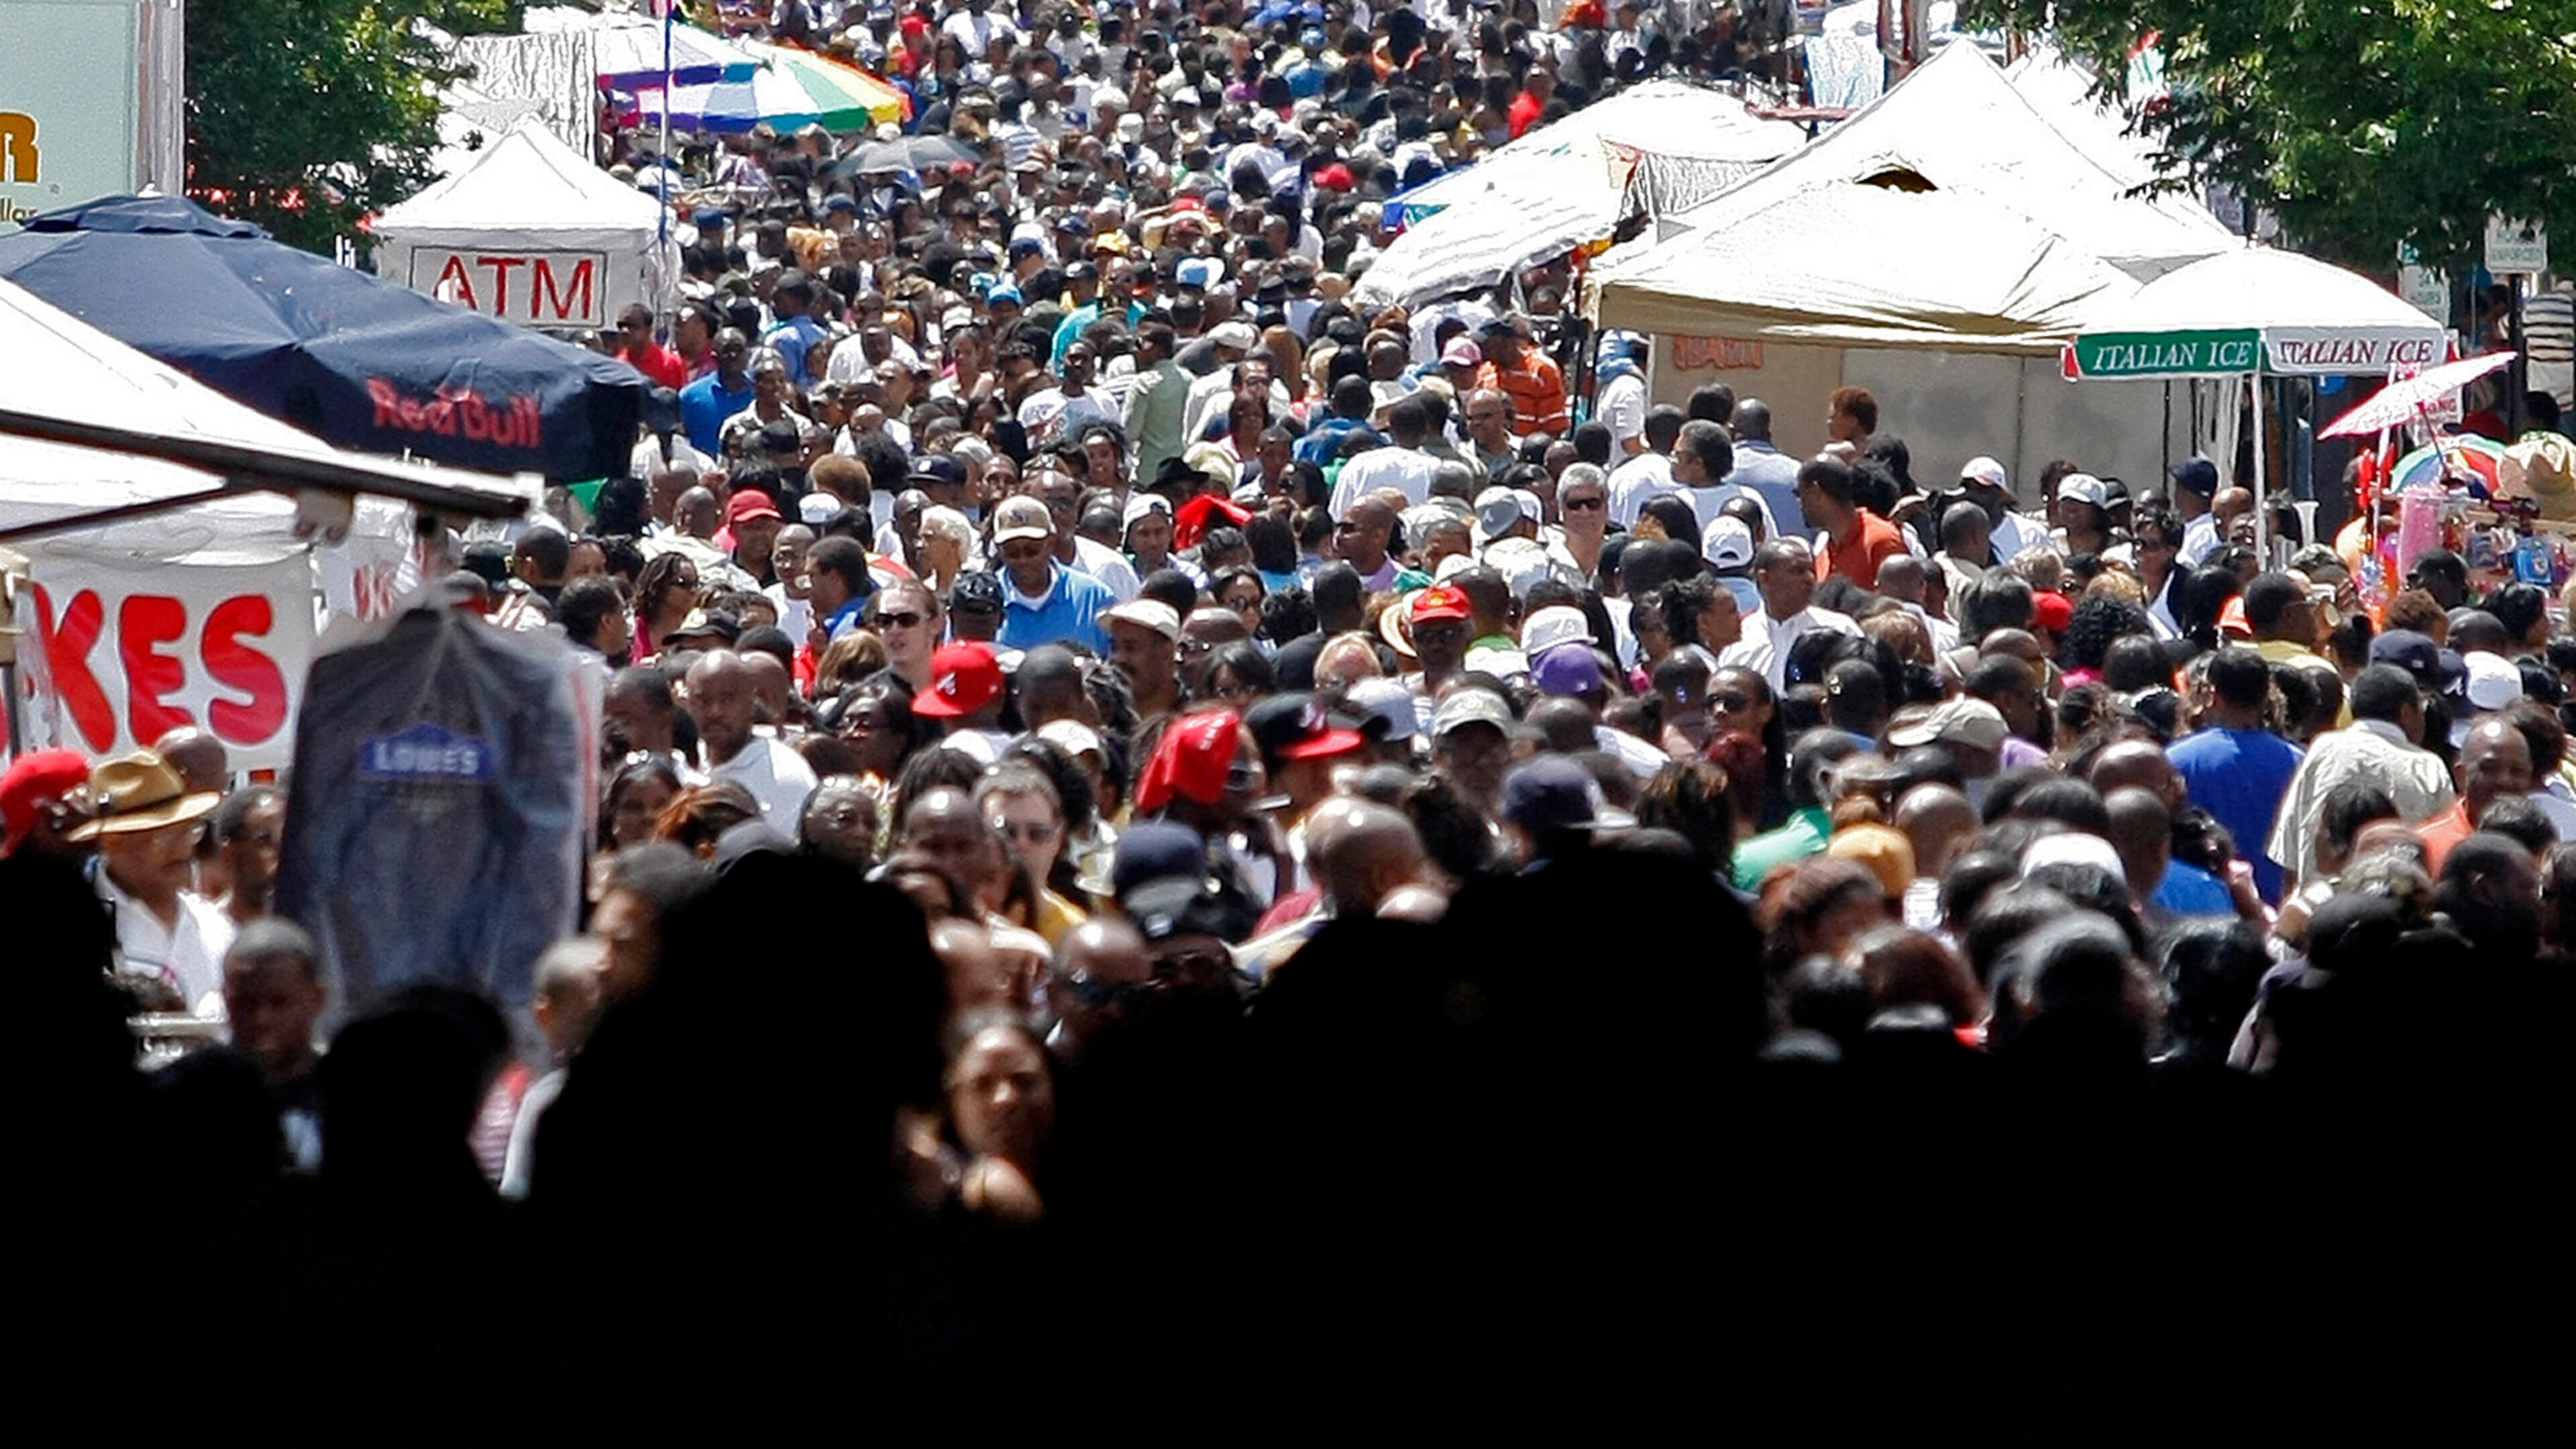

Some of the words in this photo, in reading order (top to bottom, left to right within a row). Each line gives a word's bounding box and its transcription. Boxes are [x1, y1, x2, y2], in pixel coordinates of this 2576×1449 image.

[433, 255, 595, 319] ATM
[2092, 342, 2198, 371] ITALIAN
[2207, 340, 2253, 367] ICE
[2280, 339, 2378, 364] ITALIAN
[2383, 339, 2434, 365] ICE
[366, 375, 457, 437] Red
[459, 388, 542, 448] Bull
